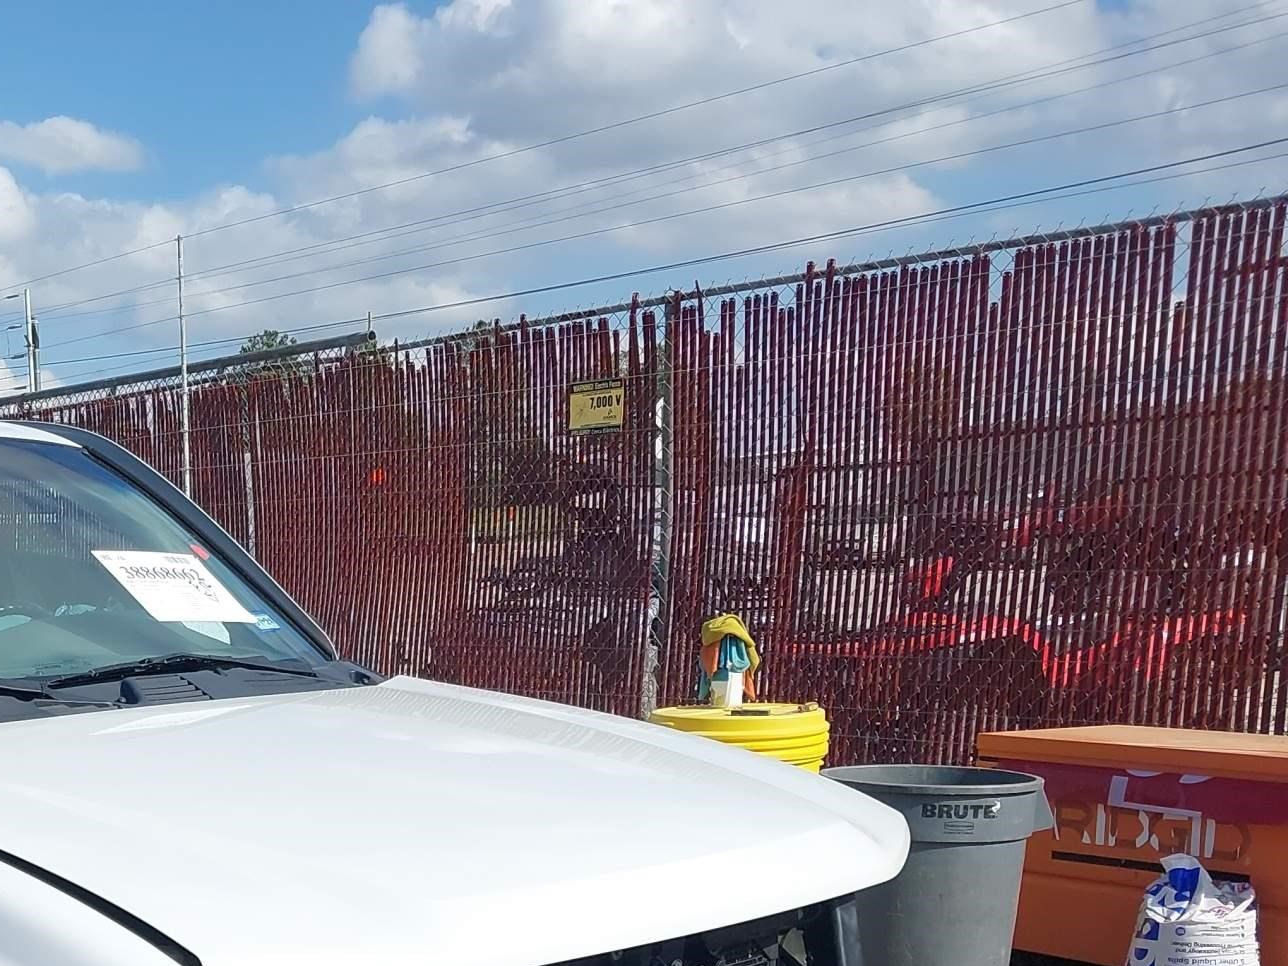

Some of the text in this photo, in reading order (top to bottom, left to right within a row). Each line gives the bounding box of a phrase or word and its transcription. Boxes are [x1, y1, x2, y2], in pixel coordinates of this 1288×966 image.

[590, 395, 613, 411] 7,000
[616, 394, 621, 406] V
[120, 566, 204, 581] 38868662
[921, 803, 997, 819] BRUTE
[1167, 957, 1190, 965] Spills
[1192, 958, 1217, 966] Liquid
